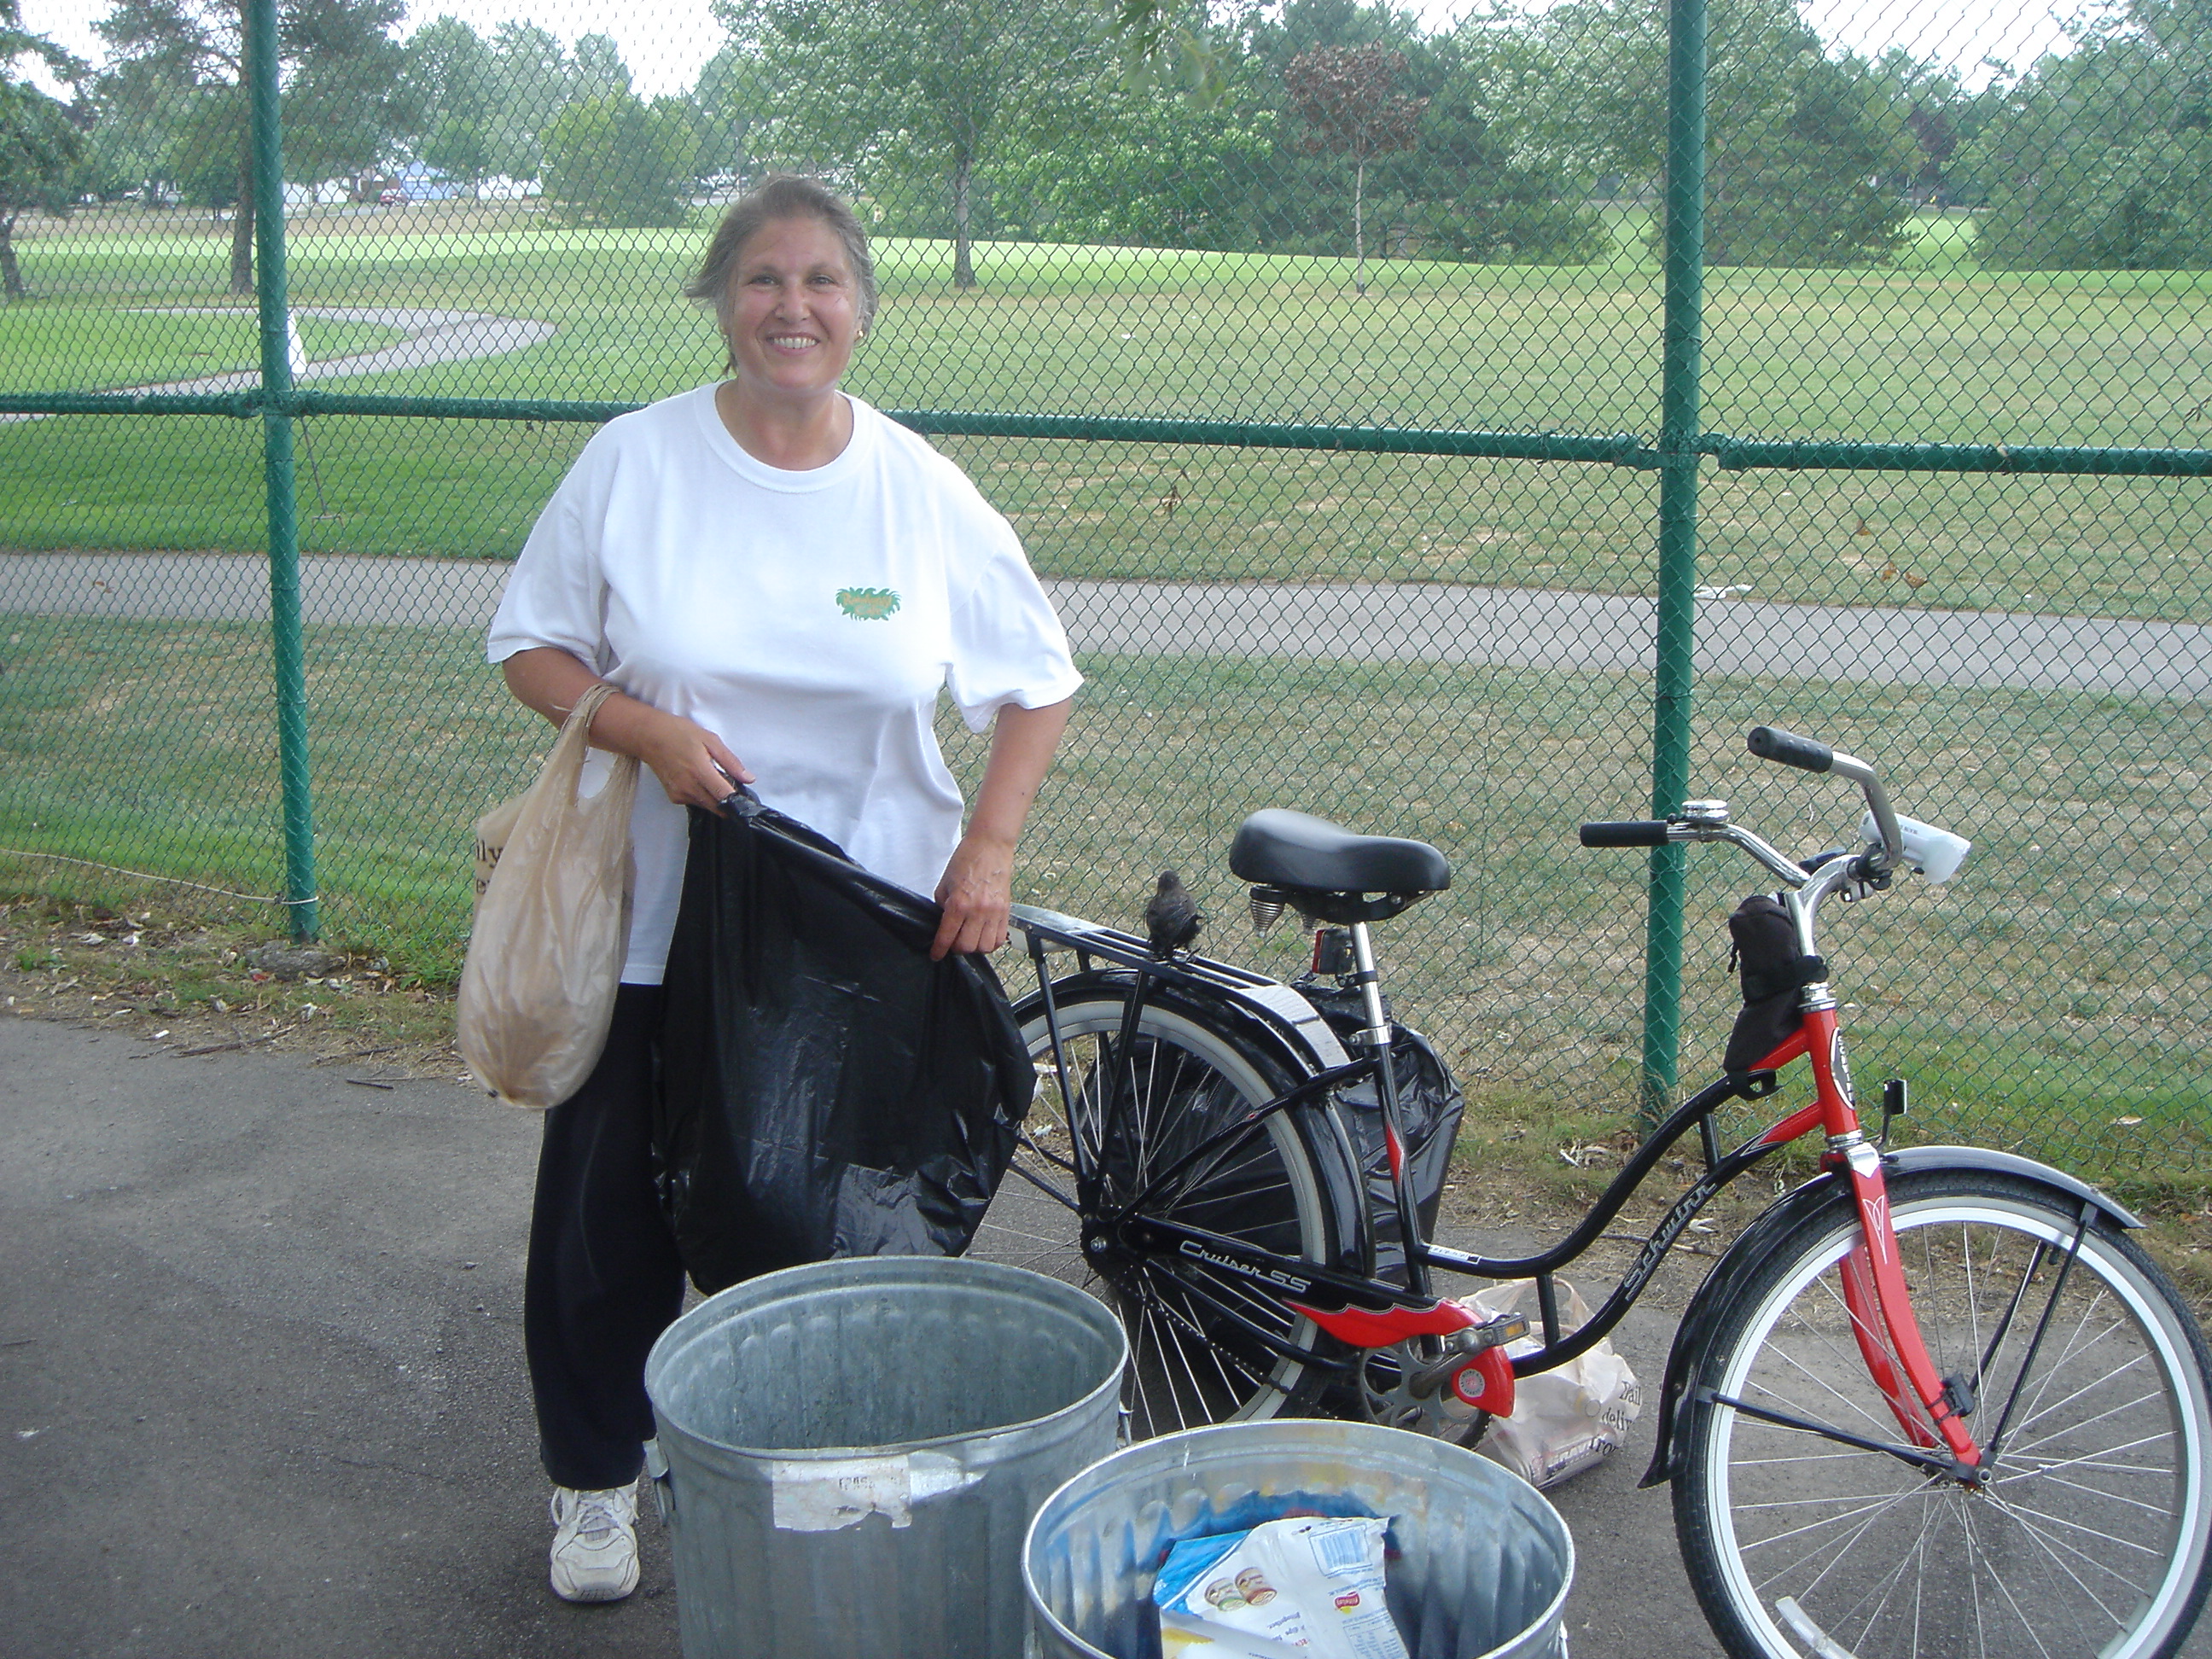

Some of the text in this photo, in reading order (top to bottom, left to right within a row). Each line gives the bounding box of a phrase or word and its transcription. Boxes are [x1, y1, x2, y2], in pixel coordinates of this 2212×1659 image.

[1179, 1240, 1312, 1294] Cruiser SS
[1624, 1183, 1717, 1301] Schwinn
[1619, 1380, 1641, 1406] Dail
